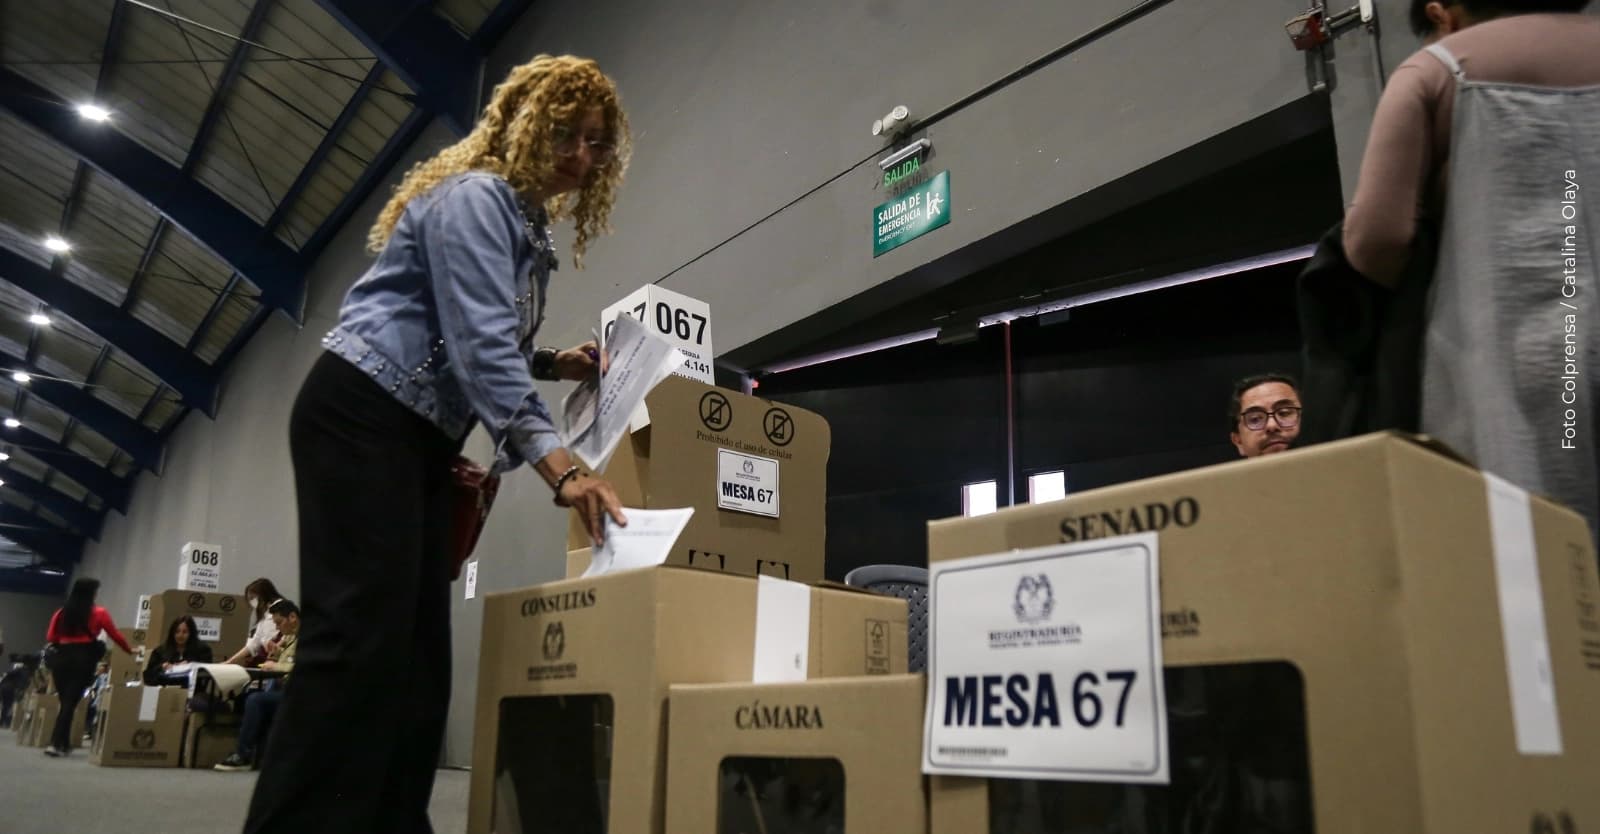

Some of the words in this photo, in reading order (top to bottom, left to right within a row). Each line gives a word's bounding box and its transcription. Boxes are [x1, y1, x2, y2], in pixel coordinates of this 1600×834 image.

[884, 158, 919, 185] SALIDA
[879, 200, 906, 224] SALIDA
[909, 192, 920, 209] DE
[879, 208, 920, 236] EMERGENCIA
[656, 302, 707, 345] 067
[684, 359, 709, 375] 4.141
[696, 430, 734, 448] Prohibido
[734, 440, 742, 450] el
[744, 444, 757, 452] uso
[759, 445, 769, 455] de
[768, 447, 793, 460] celular
[722, 481, 755, 501] MESA
[757, 488, 774, 504] 67
[1059, 496, 1200, 544] SENADO
[192, 549, 218, 566] 068
[521, 588, 597, 618] CONSULTAS
[735, 698, 823, 730] CÁMARA
[944, 673, 1061, 728] MESA
[1072, 671, 1137, 728] 67
